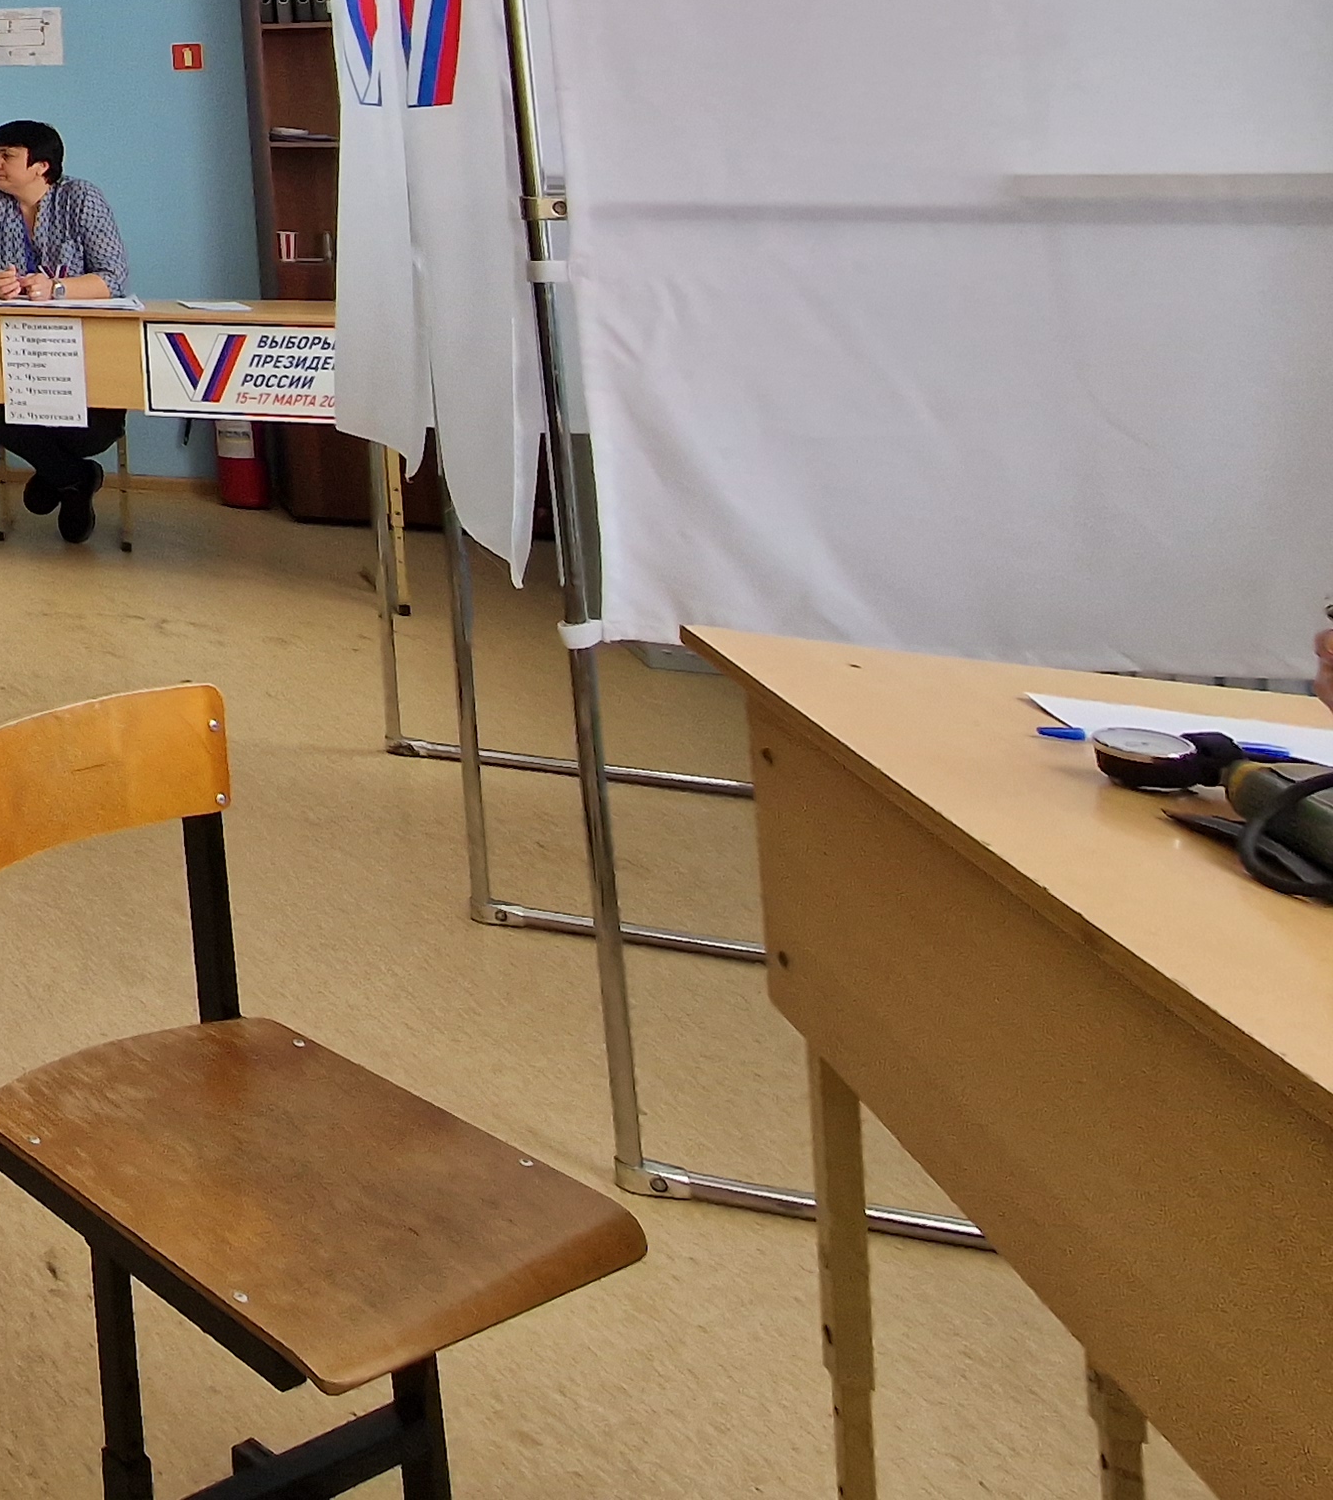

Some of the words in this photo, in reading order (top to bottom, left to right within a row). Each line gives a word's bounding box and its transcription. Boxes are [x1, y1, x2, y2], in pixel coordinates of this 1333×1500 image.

[257, 335, 335, 351] ВЫБОРЫ
[248, 353, 335, 372] ПРЕЗИДЕ
[240, 373, 316, 390] РОССИИ
[272, 393, 317, 407] МАРТА
